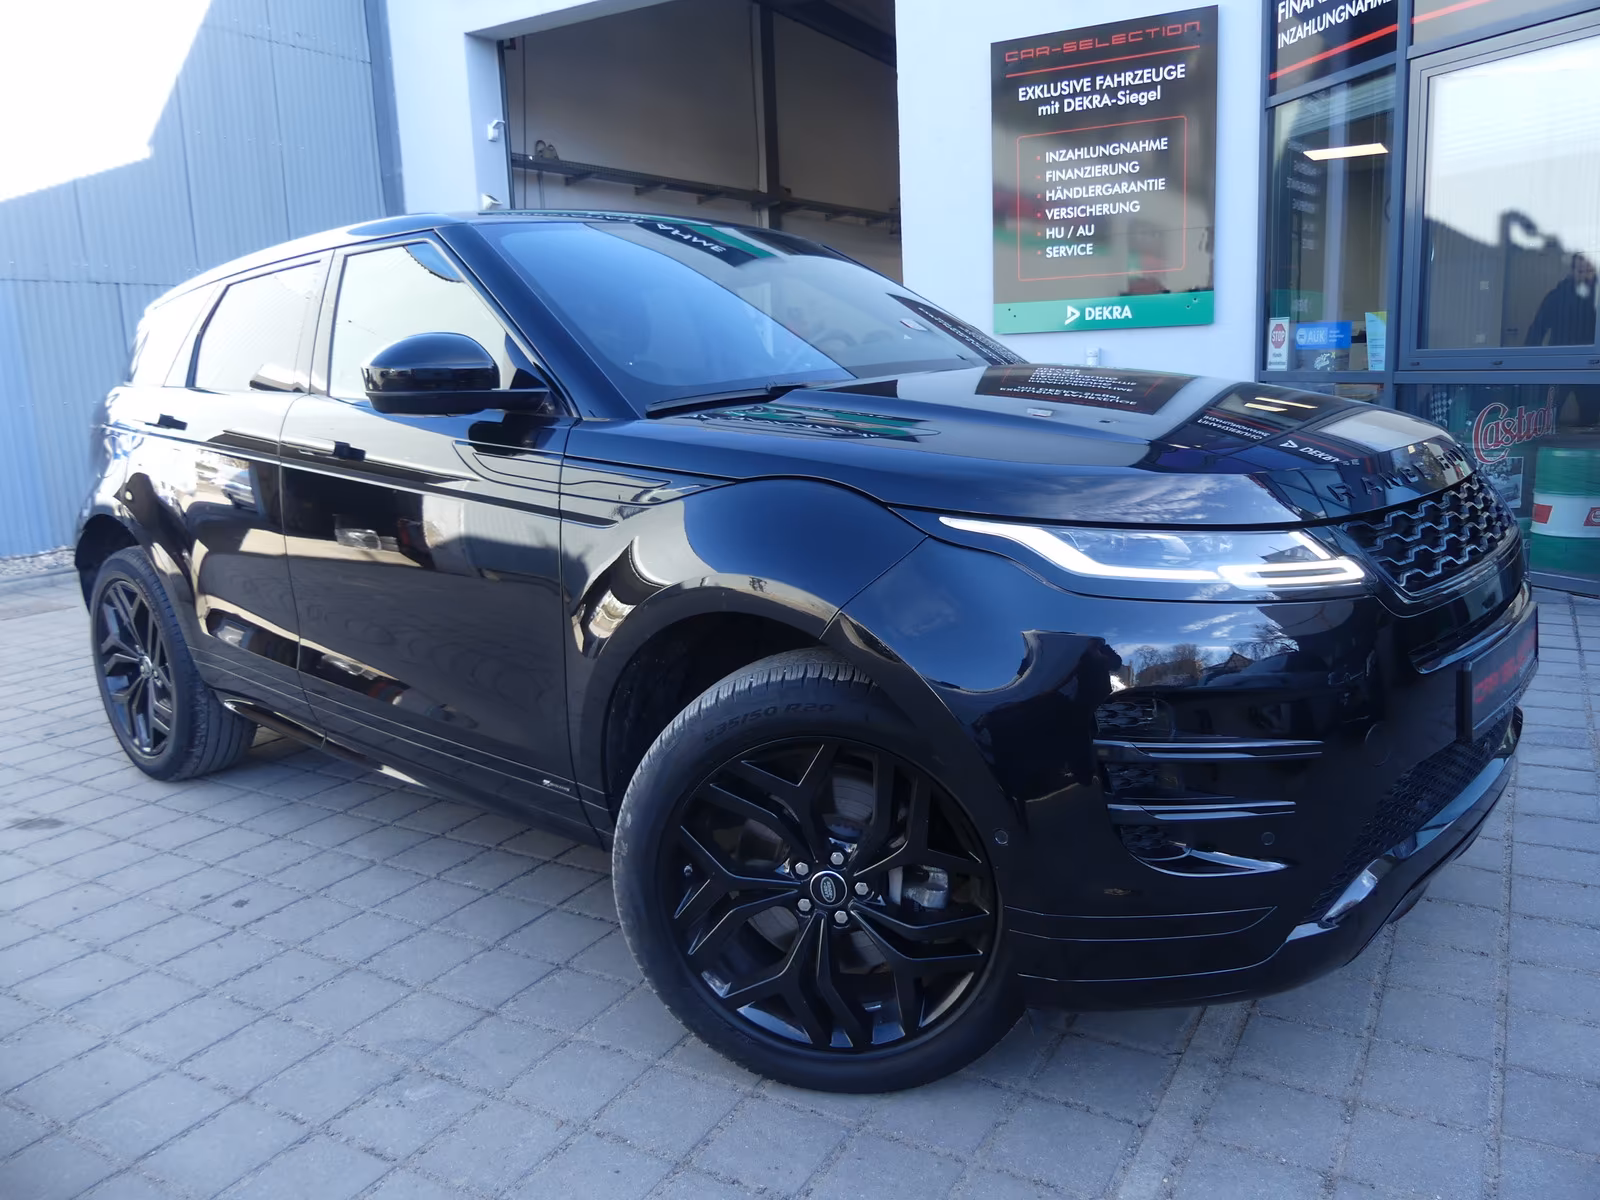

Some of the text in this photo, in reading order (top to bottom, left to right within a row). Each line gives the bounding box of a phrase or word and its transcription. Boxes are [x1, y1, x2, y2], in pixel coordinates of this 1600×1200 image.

[1278, 0, 1328, 23] FINA
[1278, 0, 1391, 49] INZAHLUNGNAH
[1005, 21, 1200, 63] CAR-SELECTION
[1018, 64, 1186, 102] EXKLUSIVE FAHRZEUGE
[1038, 85, 1161, 117] mit DEKRA-Siegel
[1045, 137, 1169, 164] INZAHLUNGNAHME
[1045, 161, 1140, 182] FINANZIERUNG
[1045, 178, 1166, 201] HÄNDLERGARANTIE
[1045, 200, 1141, 220] VERSICHERUNG
[1045, 224, 1095, 239] HU / AU
[1045, 243, 1094, 258] SERVICE
[1085, 305, 1133, 321] DEKRA
[1271, 330, 1286, 342] STOP
[1472, 386, 1557, 464] Castrol
[784, 702, 835, 714] R20
